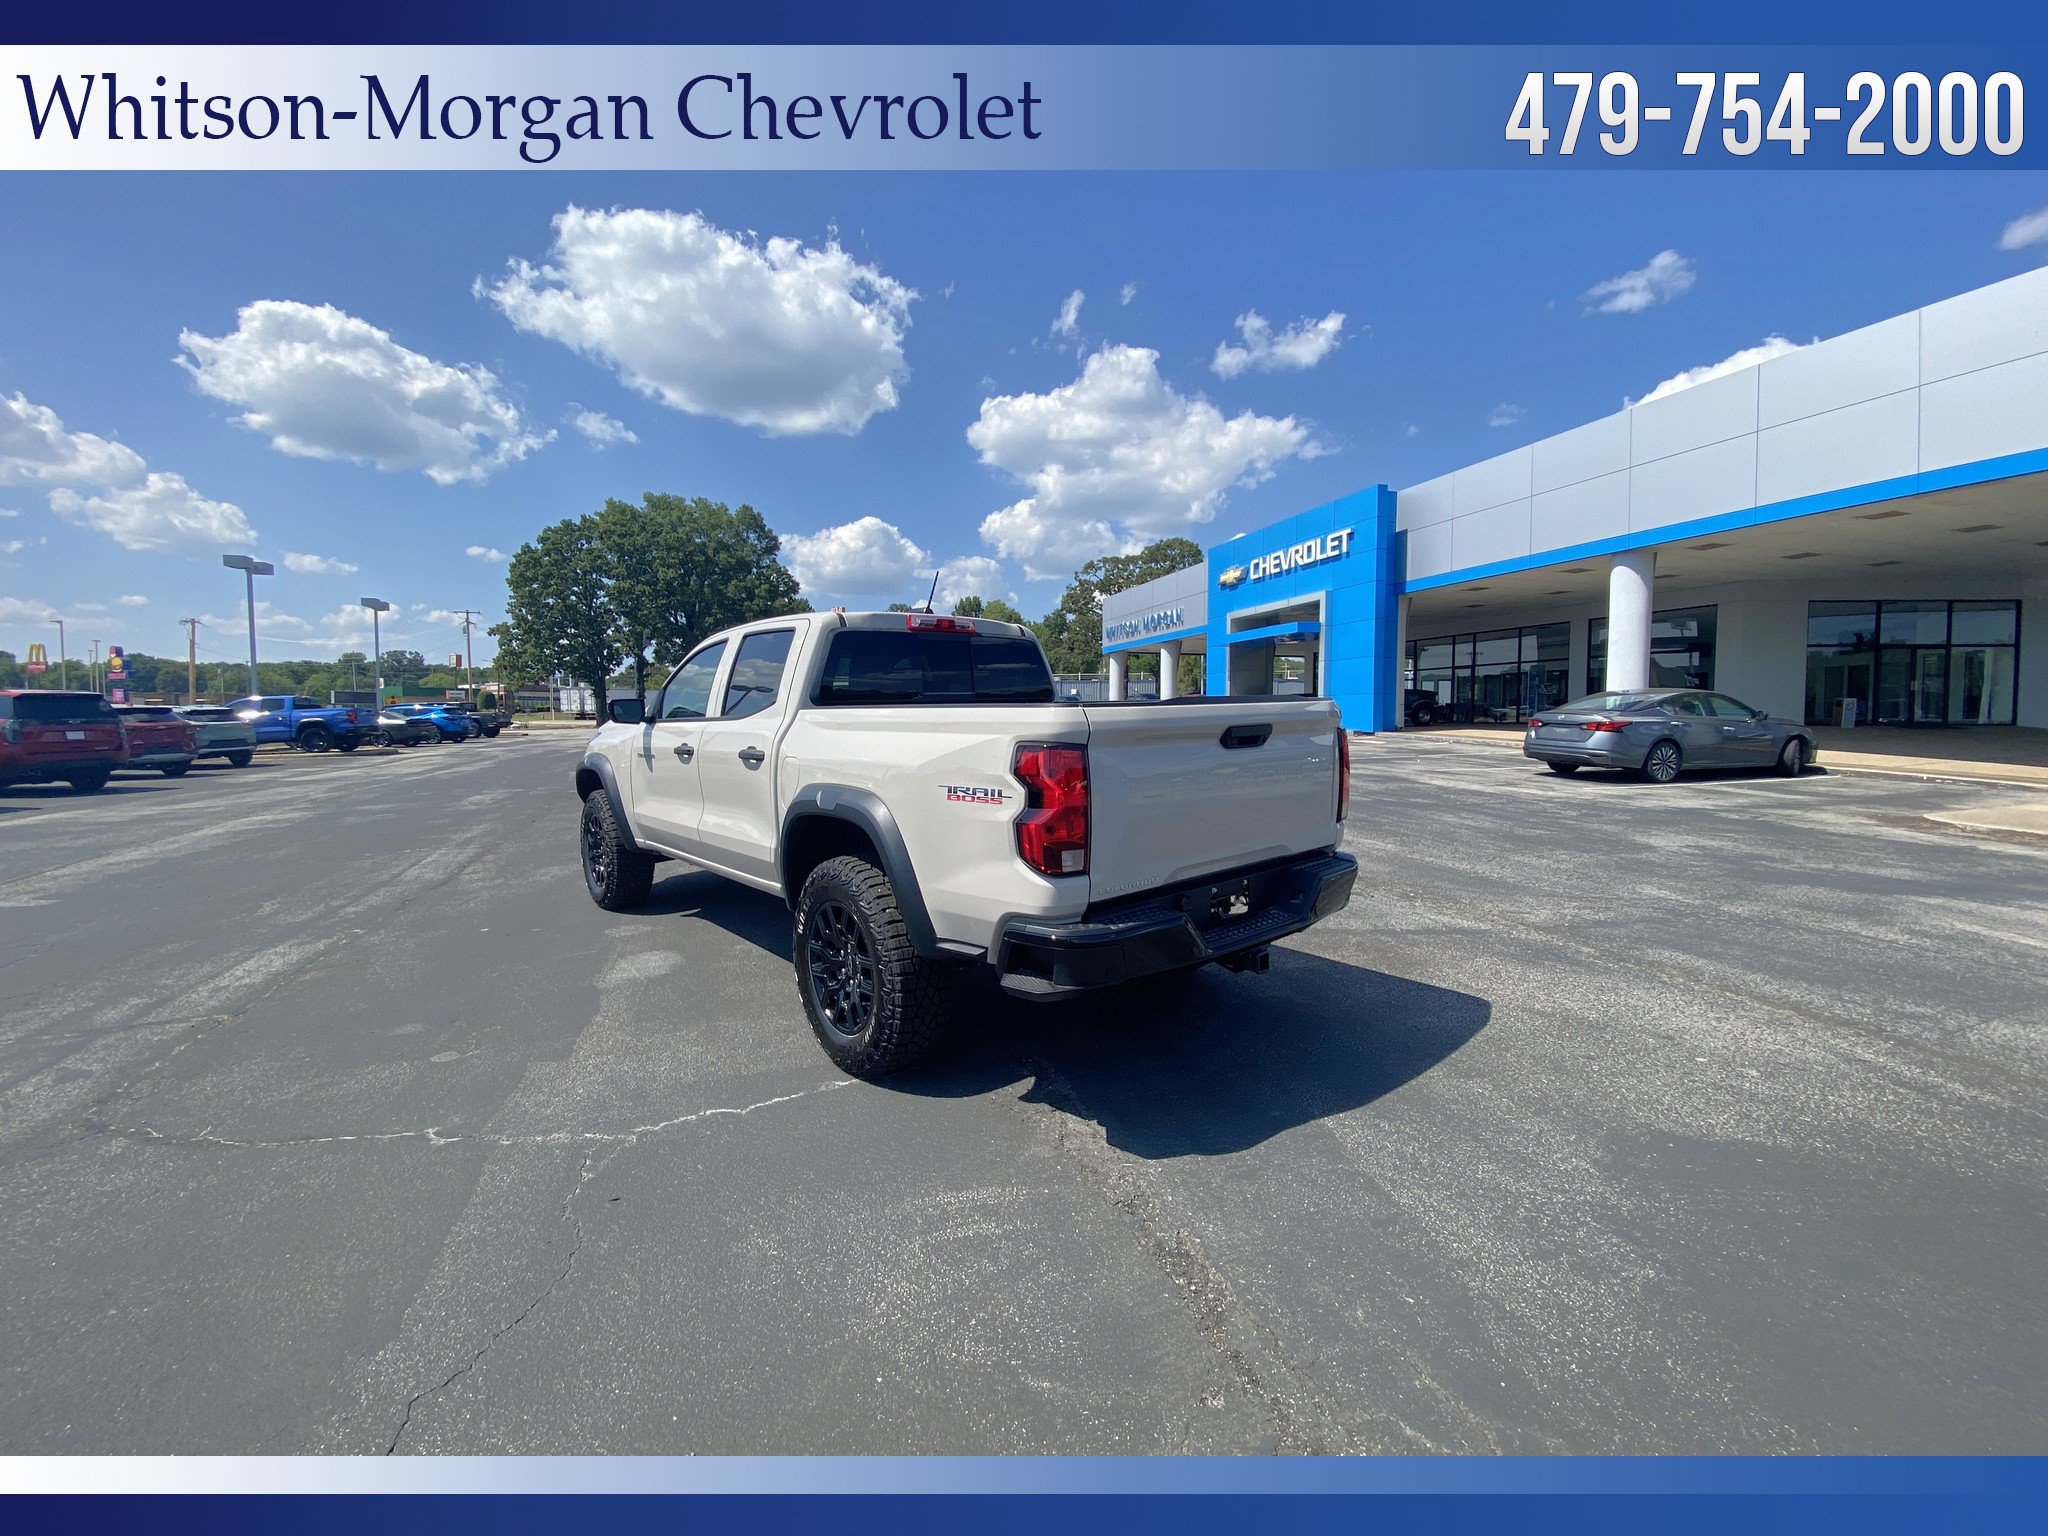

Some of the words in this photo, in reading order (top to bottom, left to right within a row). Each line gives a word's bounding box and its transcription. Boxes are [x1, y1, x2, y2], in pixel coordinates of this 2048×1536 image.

[1249, 527, 1353, 580] CHEVROLET
[1143, 606, 1184, 630] MORGAN
[938, 785, 1013, 799] TRAIL
[946, 795, 1003, 805] BOSS
